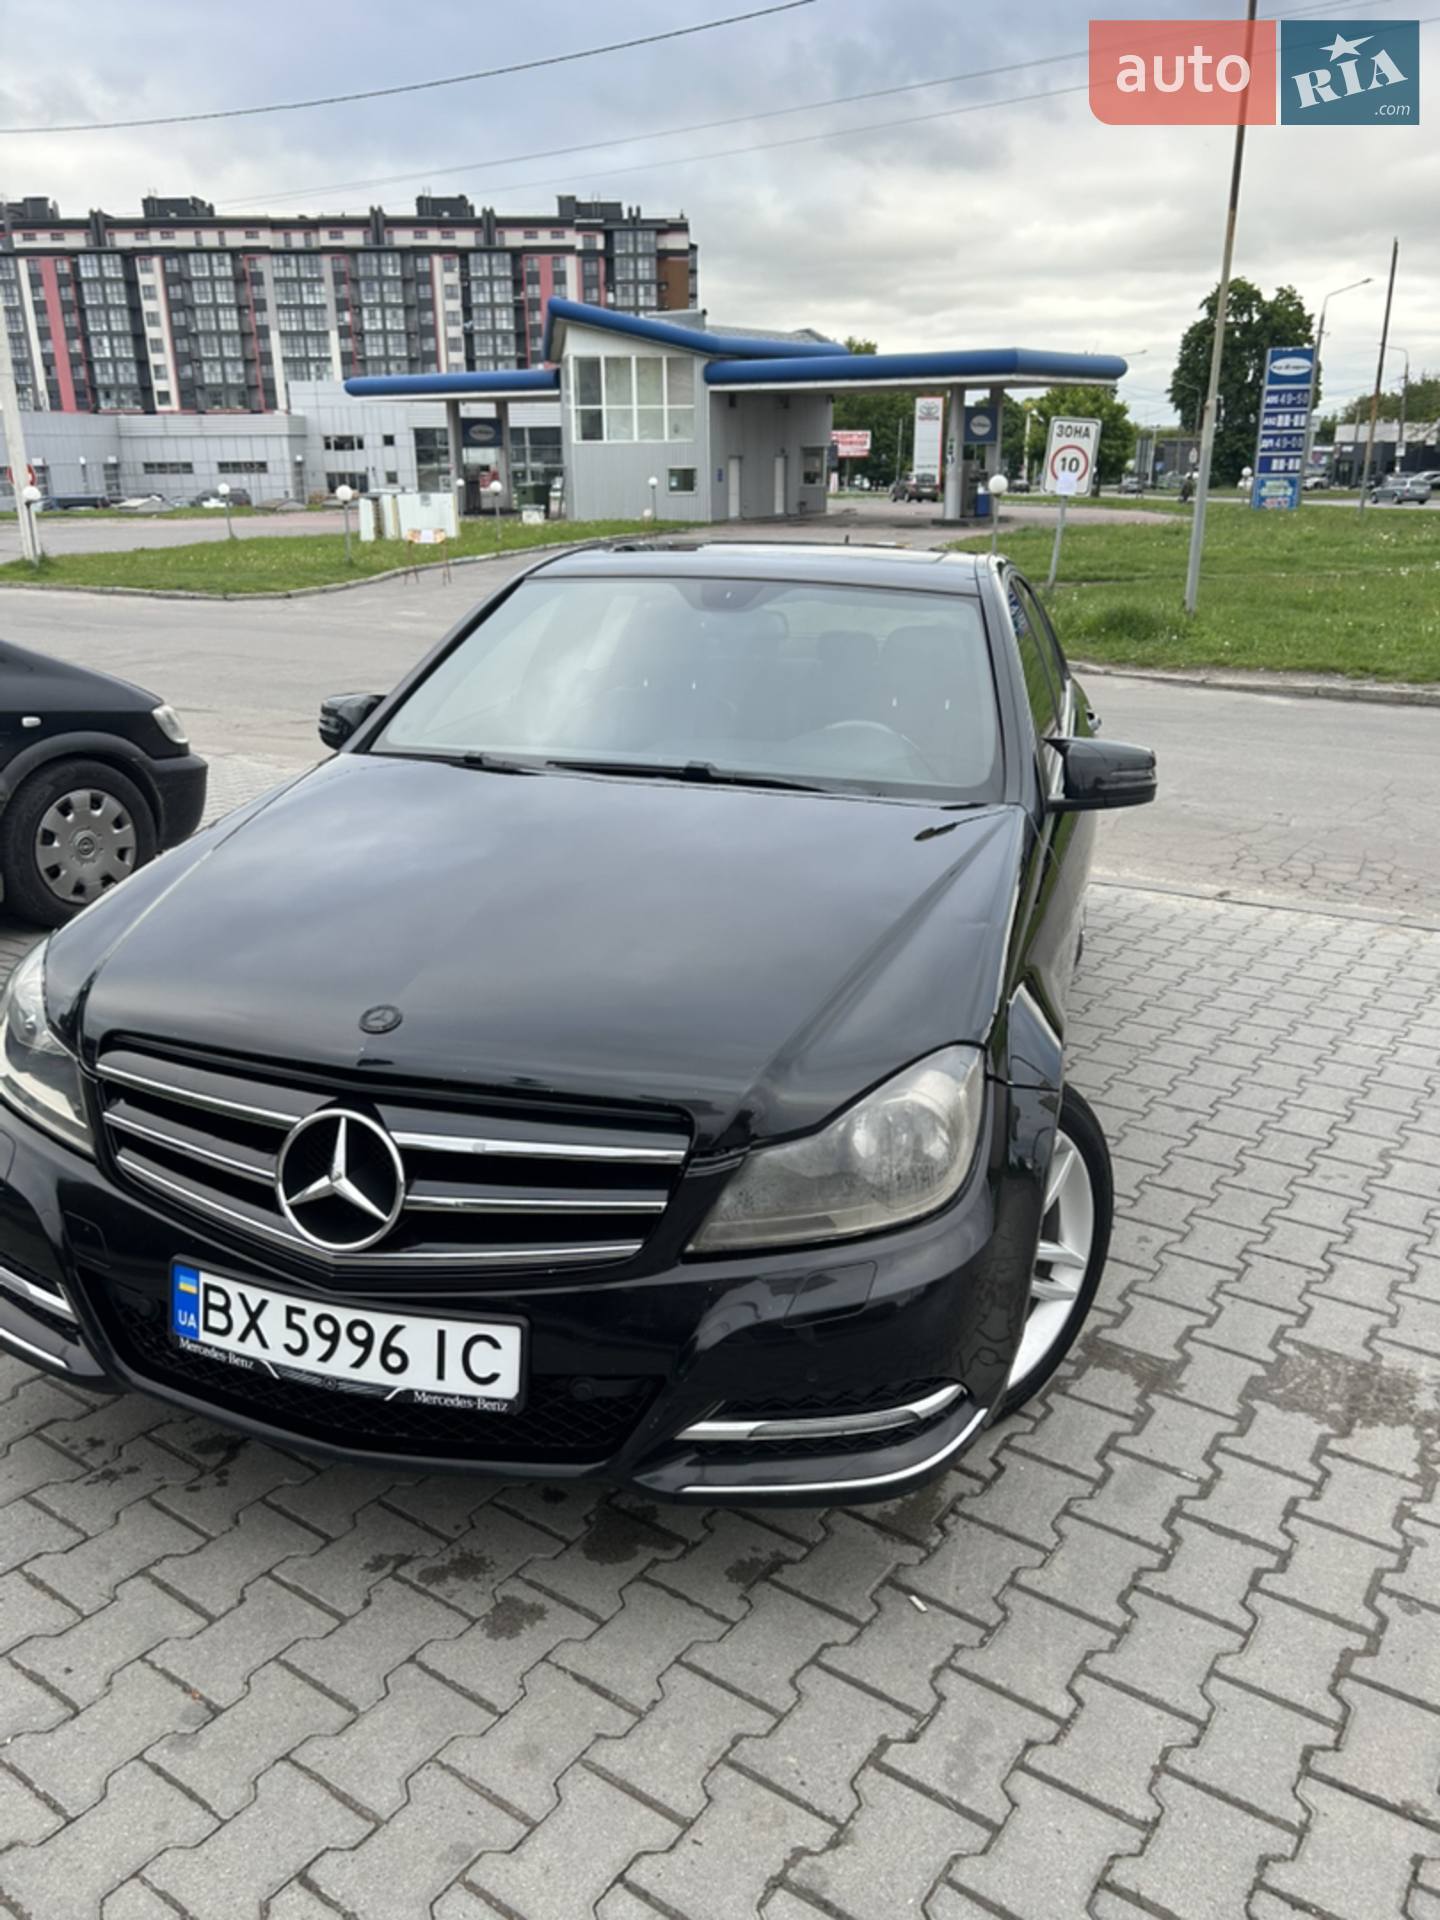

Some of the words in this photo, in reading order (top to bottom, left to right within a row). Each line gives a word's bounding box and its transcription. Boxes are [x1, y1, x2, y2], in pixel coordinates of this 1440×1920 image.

[1056, 424, 1090, 438] ЗОНА
[1060, 456, 1080, 473] 10
[178, 1310, 198, 1329] UA
[202, 1282, 270, 1351] BX
[283, 1304, 410, 1375] 5996
[436, 1328, 503, 1386] IC
[179, 1337, 255, 1370] Mercedes-Benz
[413, 1391, 508, 1412] Mercedes-Benz
